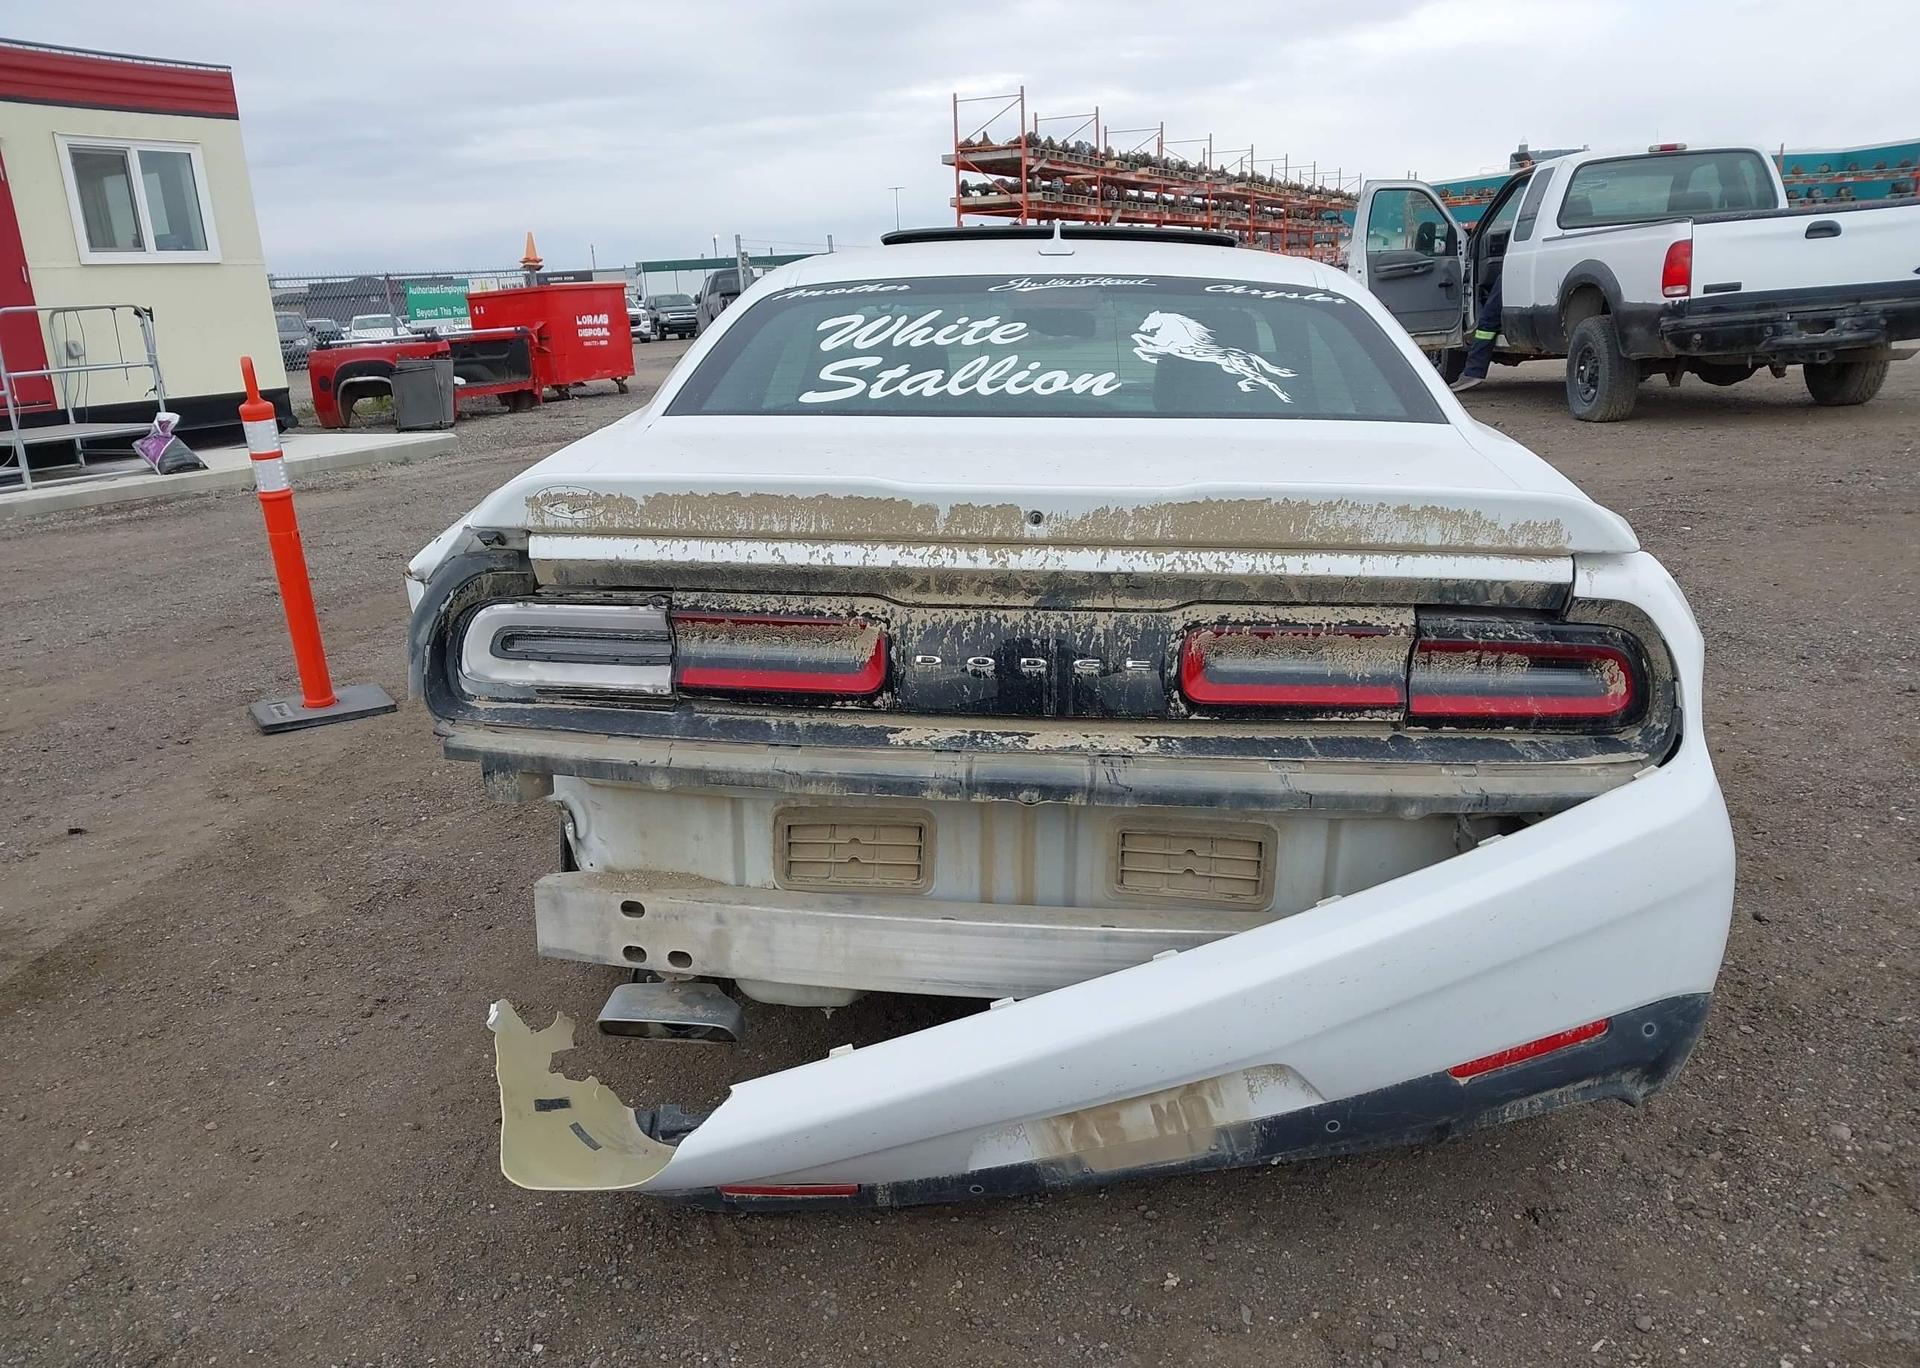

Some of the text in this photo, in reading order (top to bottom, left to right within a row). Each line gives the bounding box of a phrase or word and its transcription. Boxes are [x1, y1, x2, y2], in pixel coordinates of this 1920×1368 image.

[409, 285, 440, 294] Authorized
[1204, 285, 1347, 303] Chrysler
[416, 305, 467, 319] Beyond This Point
[577, 327, 611, 337] DISPOSAL
[816, 309, 1030, 351] White
[798, 355, 1122, 403] Stallion
[915, 655, 1152, 671] DODGE
